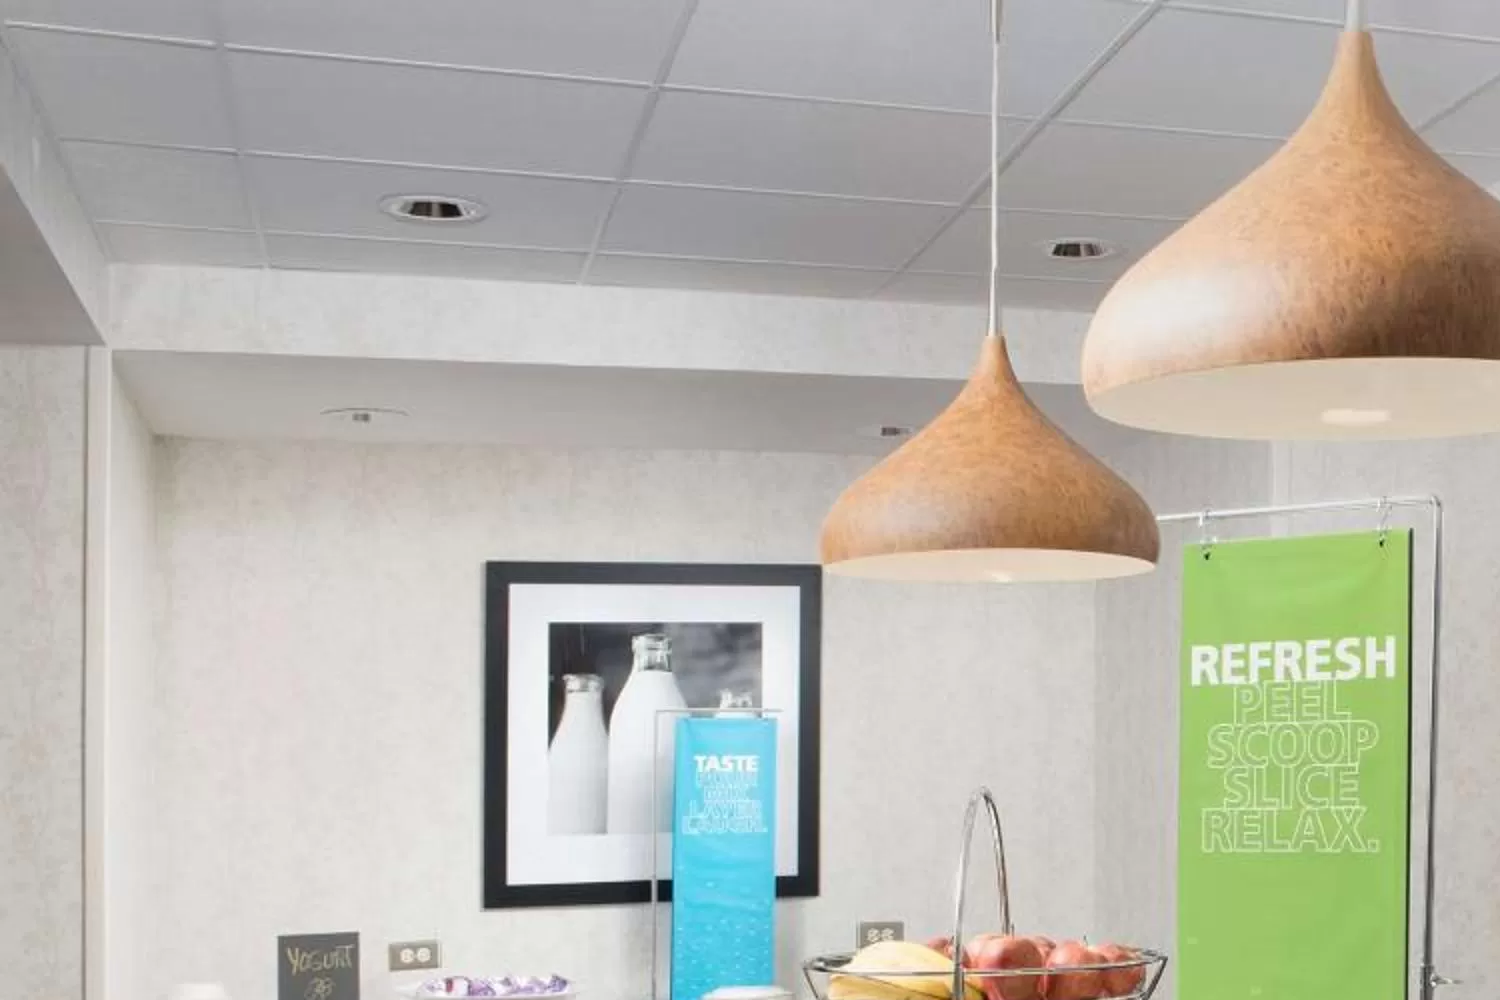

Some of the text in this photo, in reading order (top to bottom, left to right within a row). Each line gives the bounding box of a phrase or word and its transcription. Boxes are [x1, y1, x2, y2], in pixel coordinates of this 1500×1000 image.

[1190, 635, 1396, 687] REFRESH
[1233, 680, 1352, 724] PEEL
[693, 754, 760, 773] TASTE
[1207, 719, 1380, 769] SCOOP
[1223, 764, 1360, 810] SLICE
[1201, 807, 1380, 853] RELAX.
